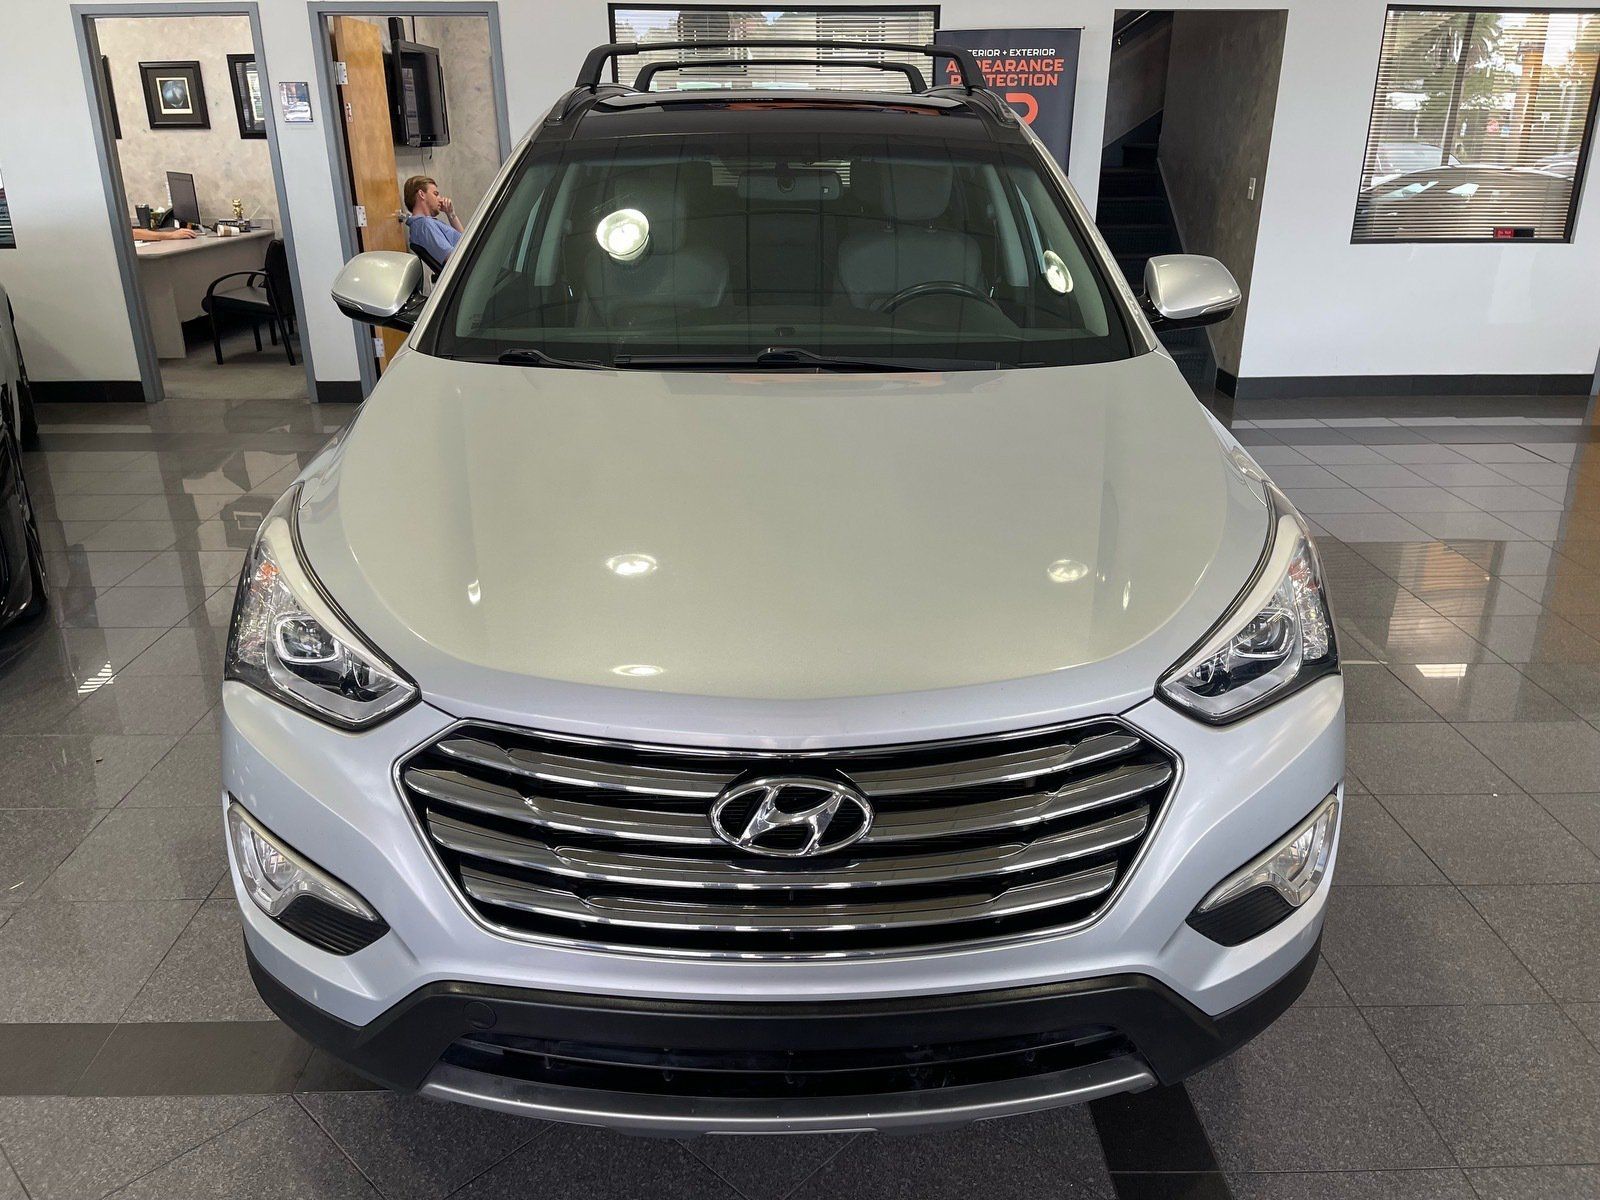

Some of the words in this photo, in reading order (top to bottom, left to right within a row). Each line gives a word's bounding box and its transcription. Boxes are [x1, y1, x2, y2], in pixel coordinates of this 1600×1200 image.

[968, 49, 1000, 57] ERIOR
[1009, 48, 1056, 57] EXTERIOR
[945, 59, 1065, 73] AEARANCE
[950, 73, 1058, 87] PTECTION
